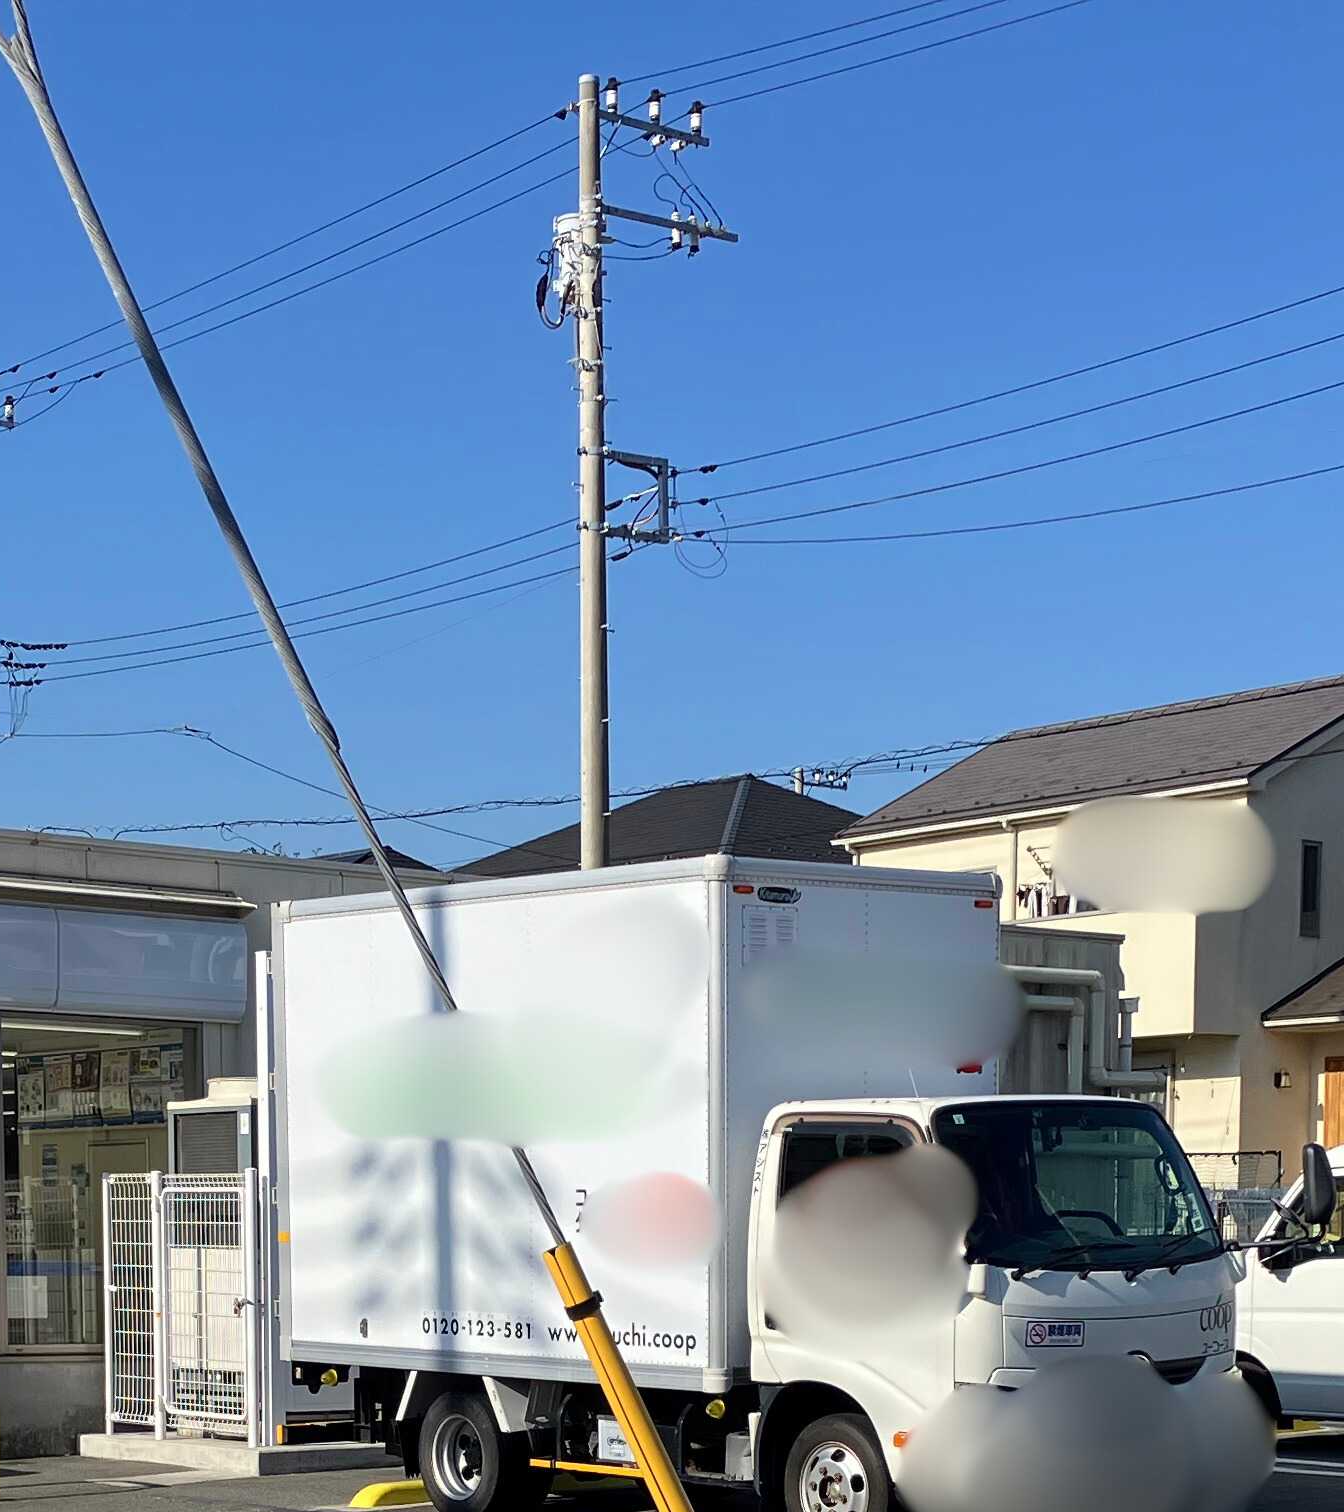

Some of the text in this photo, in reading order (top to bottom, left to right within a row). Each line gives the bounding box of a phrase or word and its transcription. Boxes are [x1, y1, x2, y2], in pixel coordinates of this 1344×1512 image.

[422, 1316, 532, 1340] 0120-123-581
[1199, 1303, 1232, 1333] coop
[548, 1322, 697, 1357] wwuchi.coop
